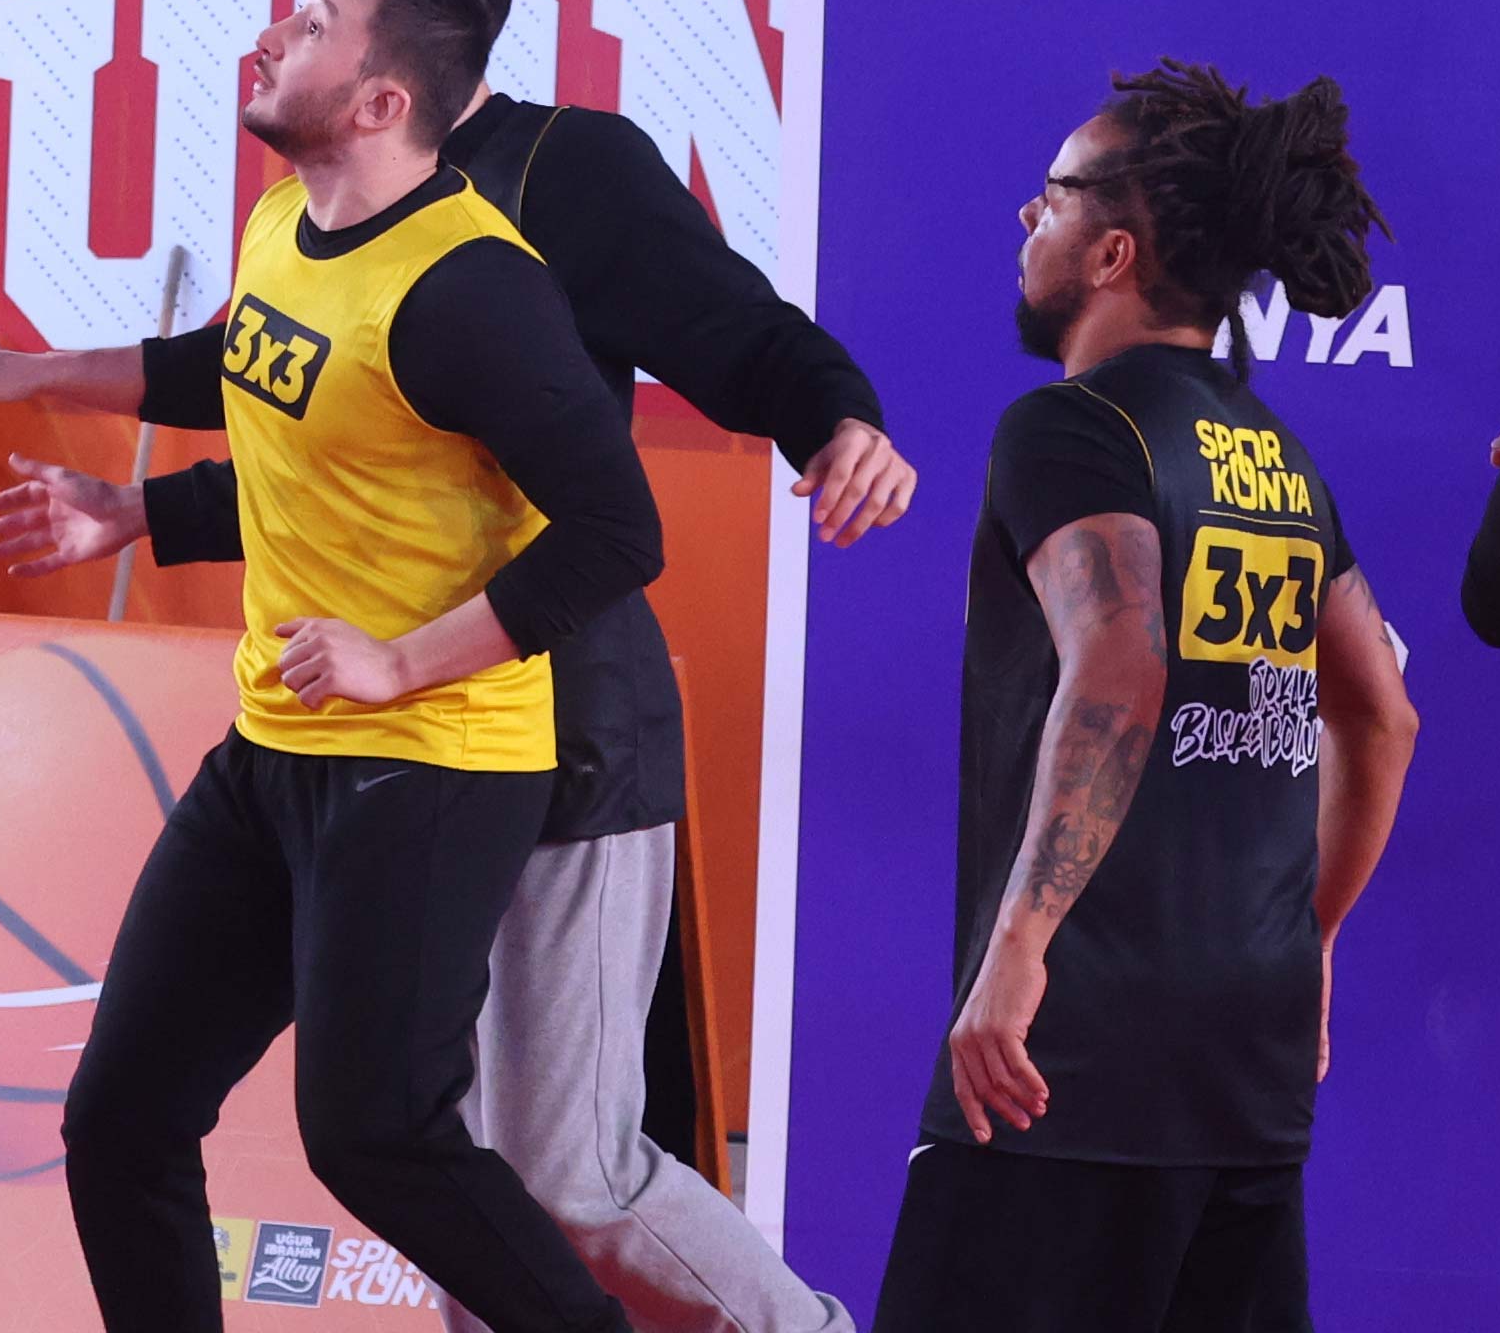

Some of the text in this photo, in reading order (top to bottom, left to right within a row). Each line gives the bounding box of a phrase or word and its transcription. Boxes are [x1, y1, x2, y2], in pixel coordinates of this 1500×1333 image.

[1211, 281, 1414, 368] NYA
[1195, 419, 1286, 471] SPOR
[1210, 455, 1313, 517] KONYA
